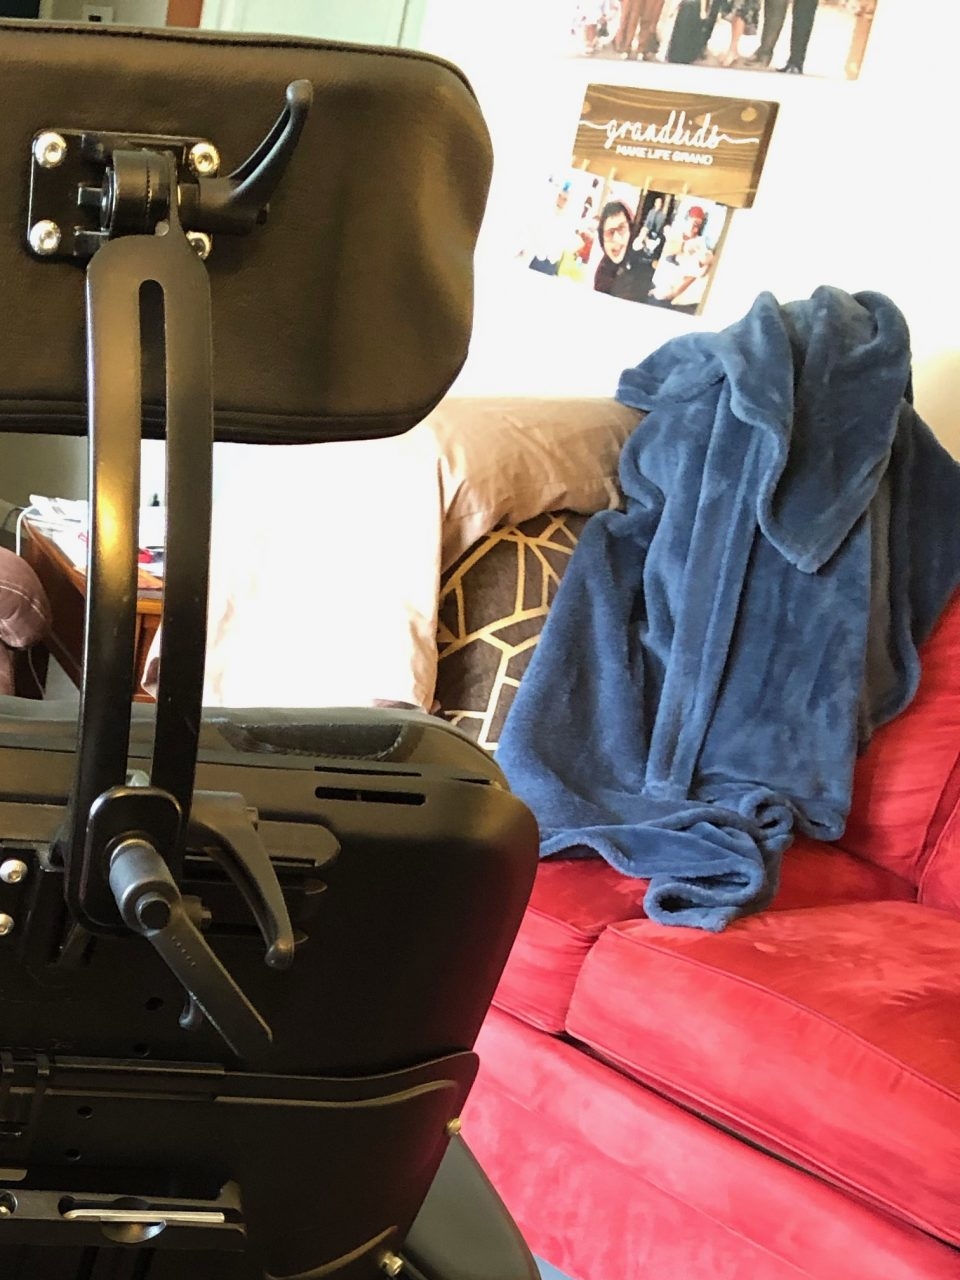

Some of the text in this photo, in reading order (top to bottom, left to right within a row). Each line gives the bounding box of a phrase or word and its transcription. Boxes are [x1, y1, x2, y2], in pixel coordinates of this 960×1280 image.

[616, 144, 713, 165] MAKE LIFE GRAND
